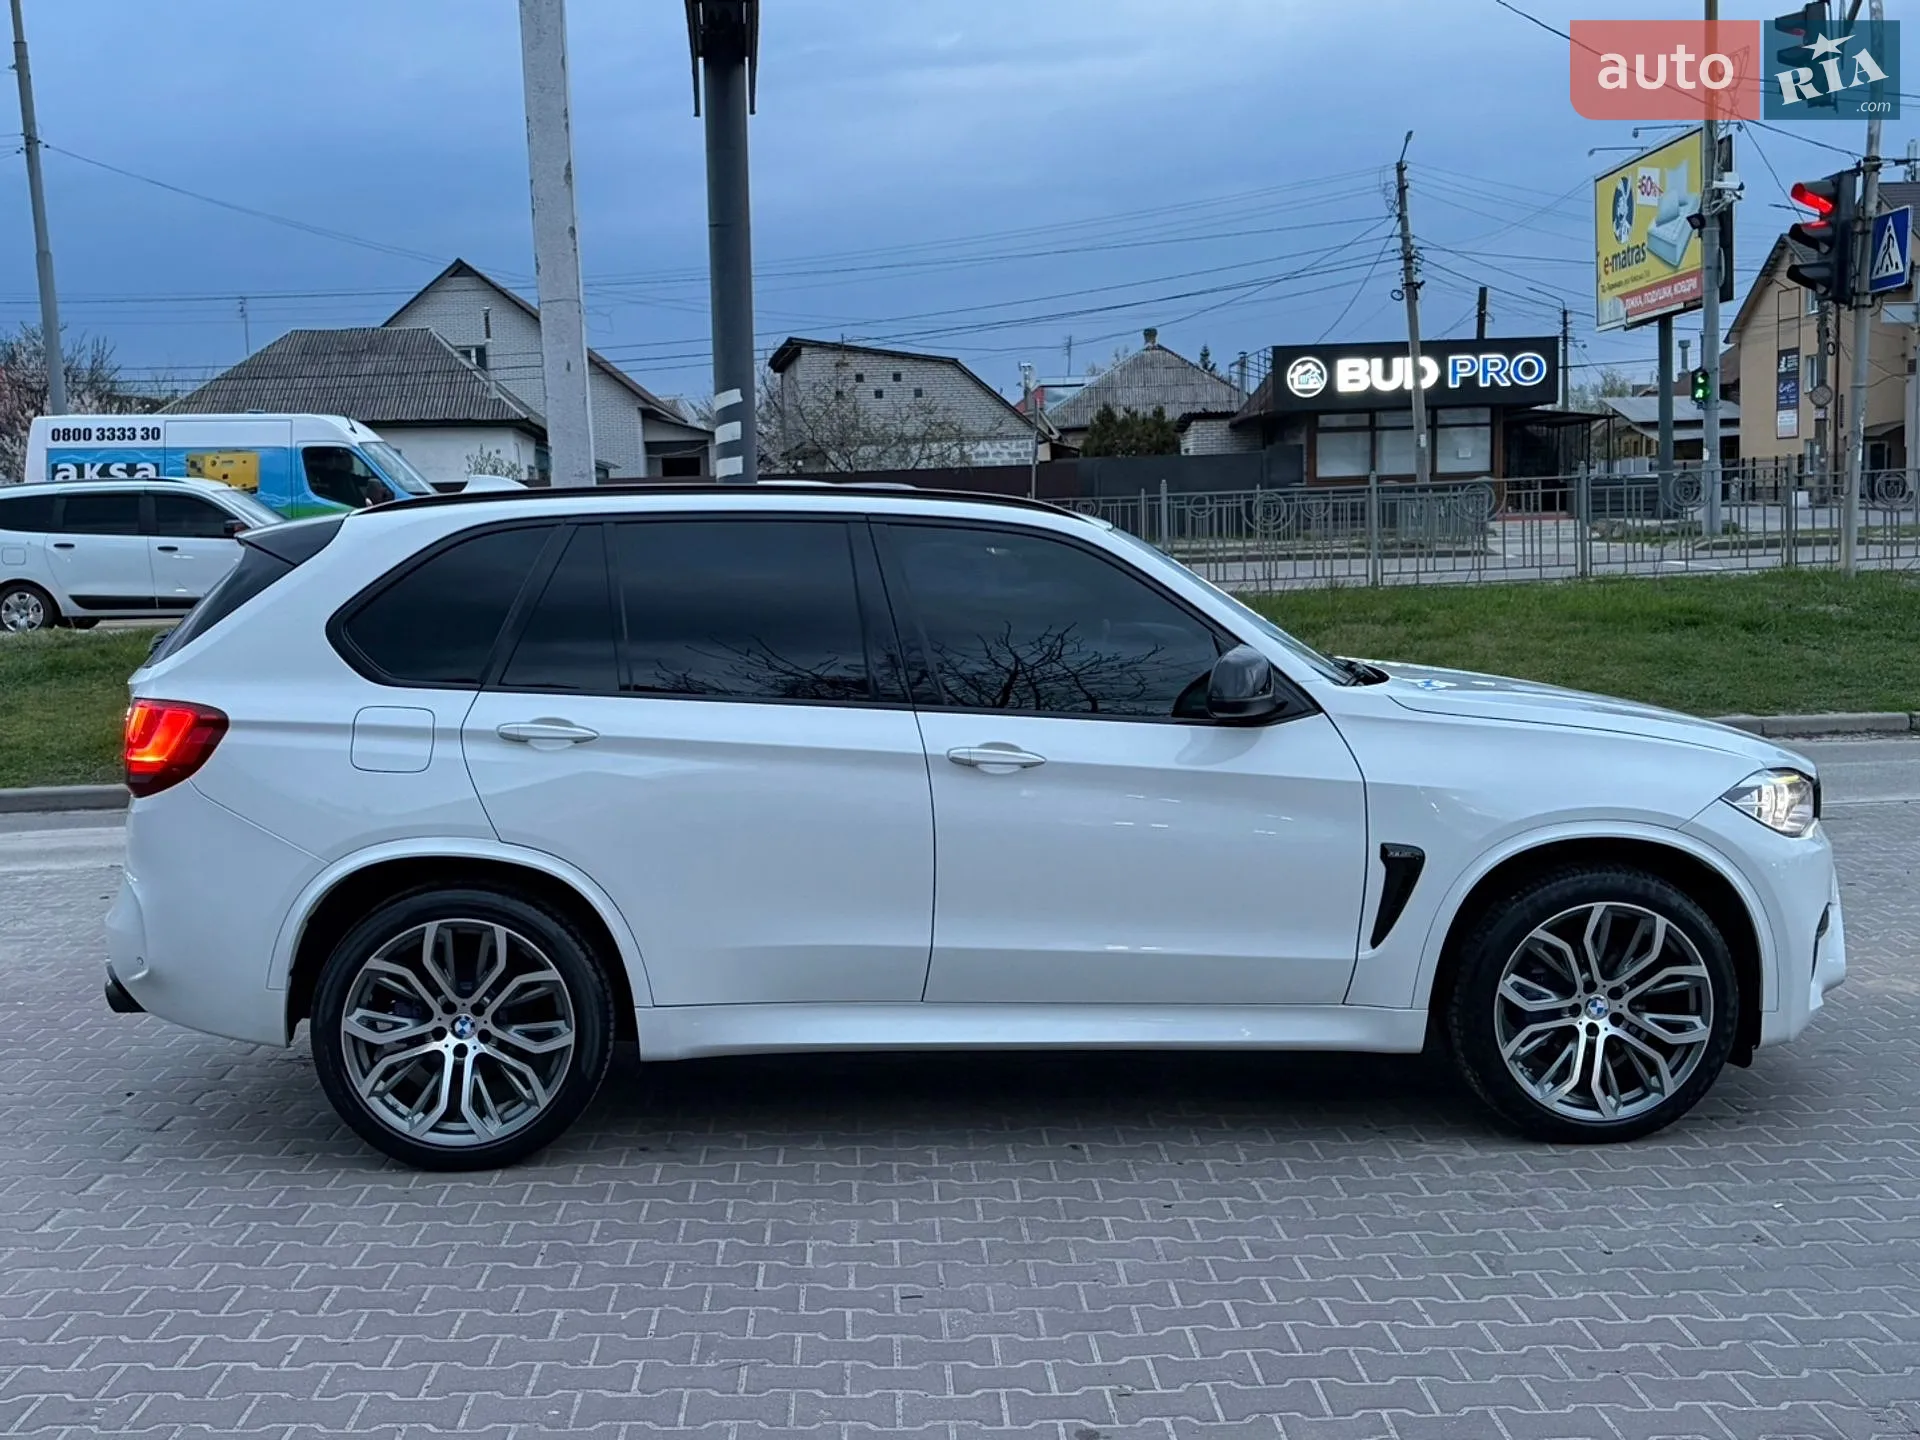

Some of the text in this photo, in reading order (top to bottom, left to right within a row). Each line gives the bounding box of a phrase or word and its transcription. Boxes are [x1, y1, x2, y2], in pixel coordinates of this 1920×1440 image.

[1603, 242, 1647, 276] e-matras
[1336, 352, 1547, 392] BUD PRO
[51, 427, 161, 442] 0800 3333 30
